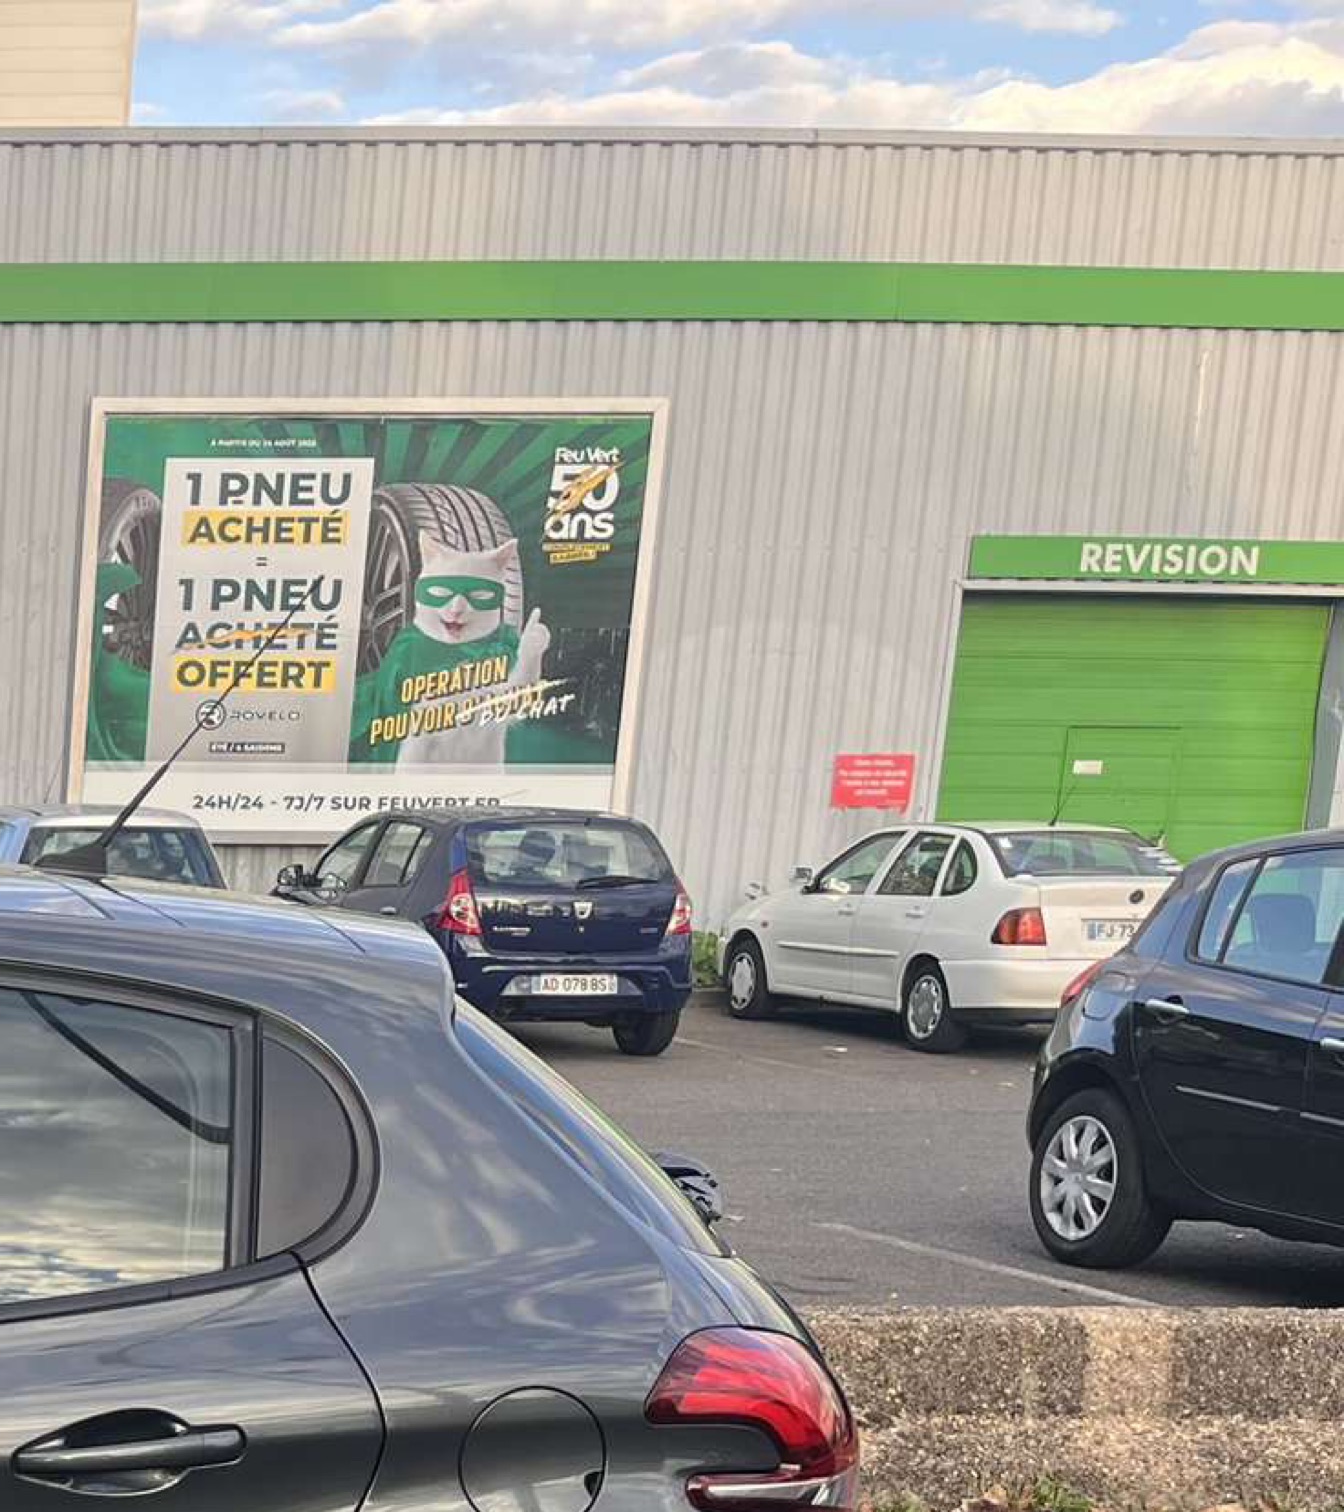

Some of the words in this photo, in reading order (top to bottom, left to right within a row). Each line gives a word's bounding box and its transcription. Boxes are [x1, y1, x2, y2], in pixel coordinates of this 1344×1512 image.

[555, 447, 584, 462] Feu
[586, 445, 620, 463] Vert
[186, 473, 202, 506] 1
[219, 473, 352, 507] PNEU
[548, 465, 620, 511] 50
[188, 509, 344, 544] ACHETÉ
[544, 512, 615, 540] ans
[1080, 541, 1260, 576] REVISION
[179, 578, 194, 611] 1
[210, 577, 343, 612] PNEU
[175, 614, 339, 651] ACHETÉ
[176, 659, 331, 688] OFFERT
[401, 655, 508, 704] OPERATION
[369, 701, 456, 746] POUVOIR
[192, 793, 264, 812] 24H/24
[283, 793, 325, 812] 7J/7
[330, 795, 372, 811] SUR
[378, 796, 501, 810] FEUVERTFR
